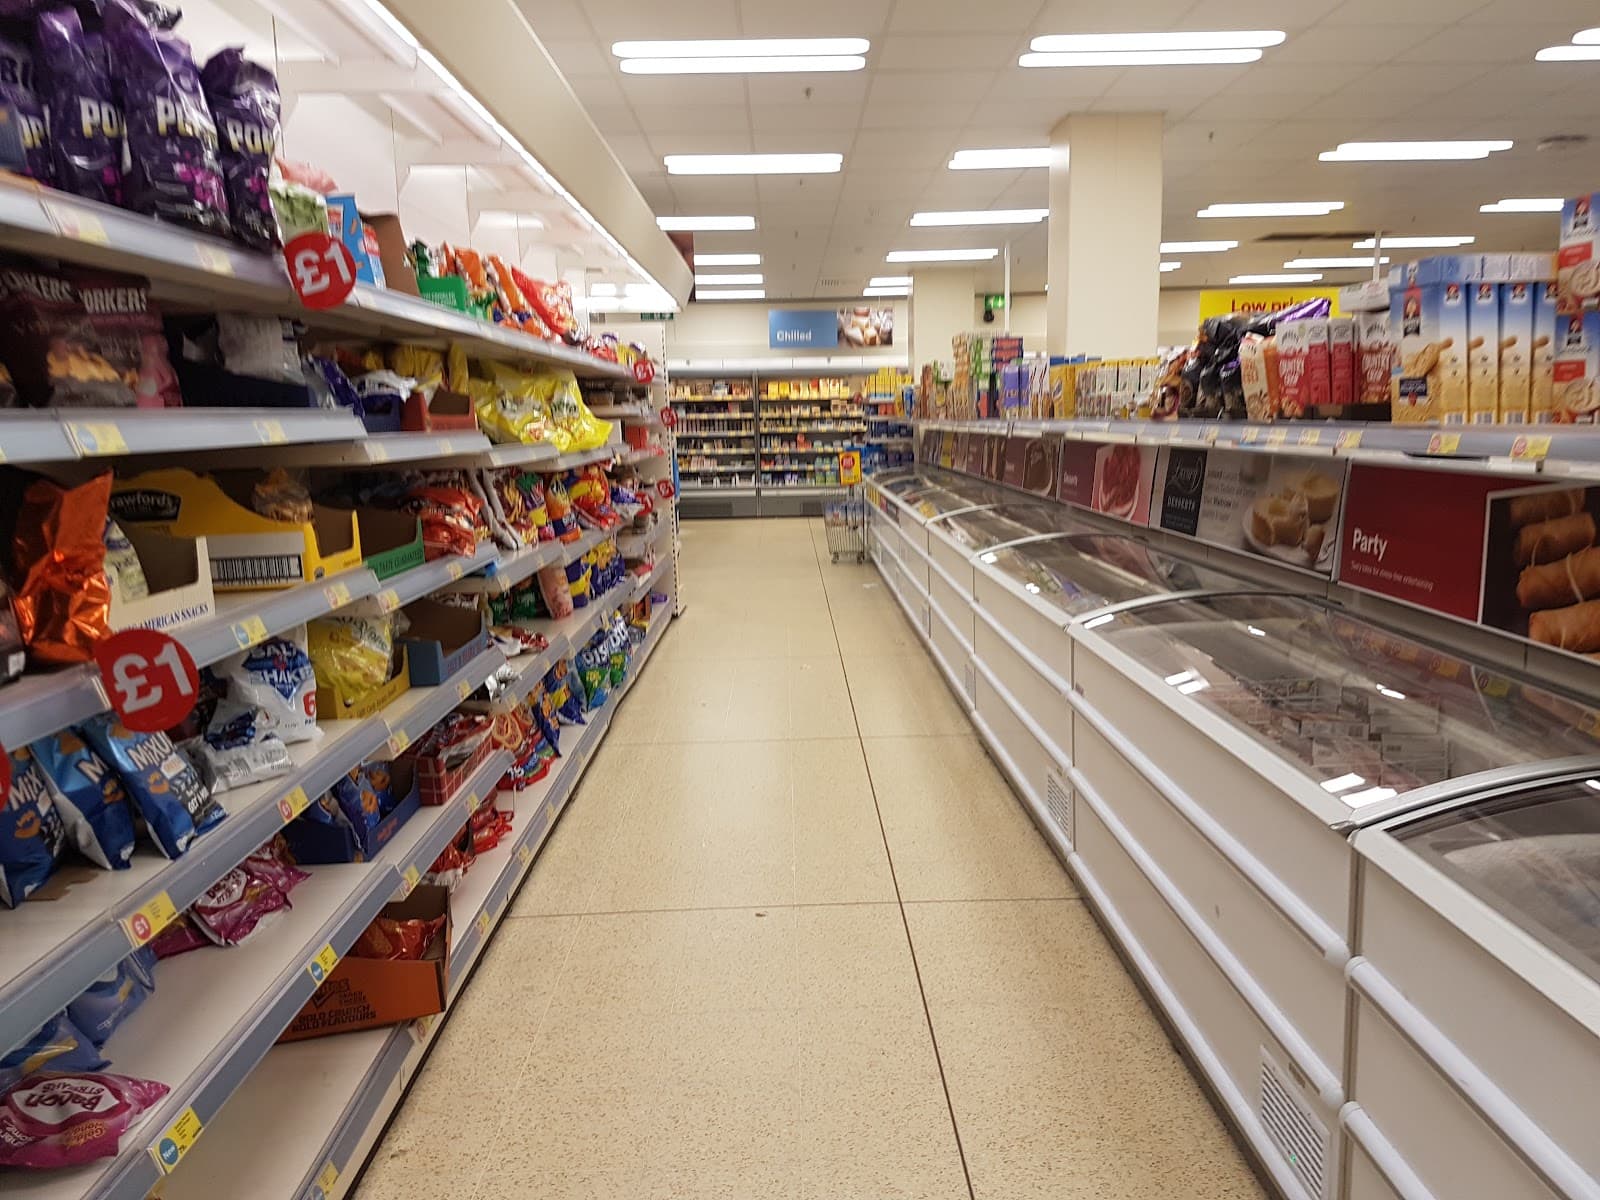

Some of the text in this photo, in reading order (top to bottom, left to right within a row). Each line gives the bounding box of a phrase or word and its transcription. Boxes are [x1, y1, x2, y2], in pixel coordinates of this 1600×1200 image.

[294, 241, 352, 297] £1
[1231, 298, 1267, 313] Low
[776, 329, 812, 342] Chilled
[1352, 527, 1388, 562] Party
[140, 603, 209, 630] AMERICAN SNACKS
[113, 641, 193, 714] £1
[303, 691, 316, 717] 6
[25, 1091, 103, 1111] Bacon
[162, 1144, 176, 1161] New
